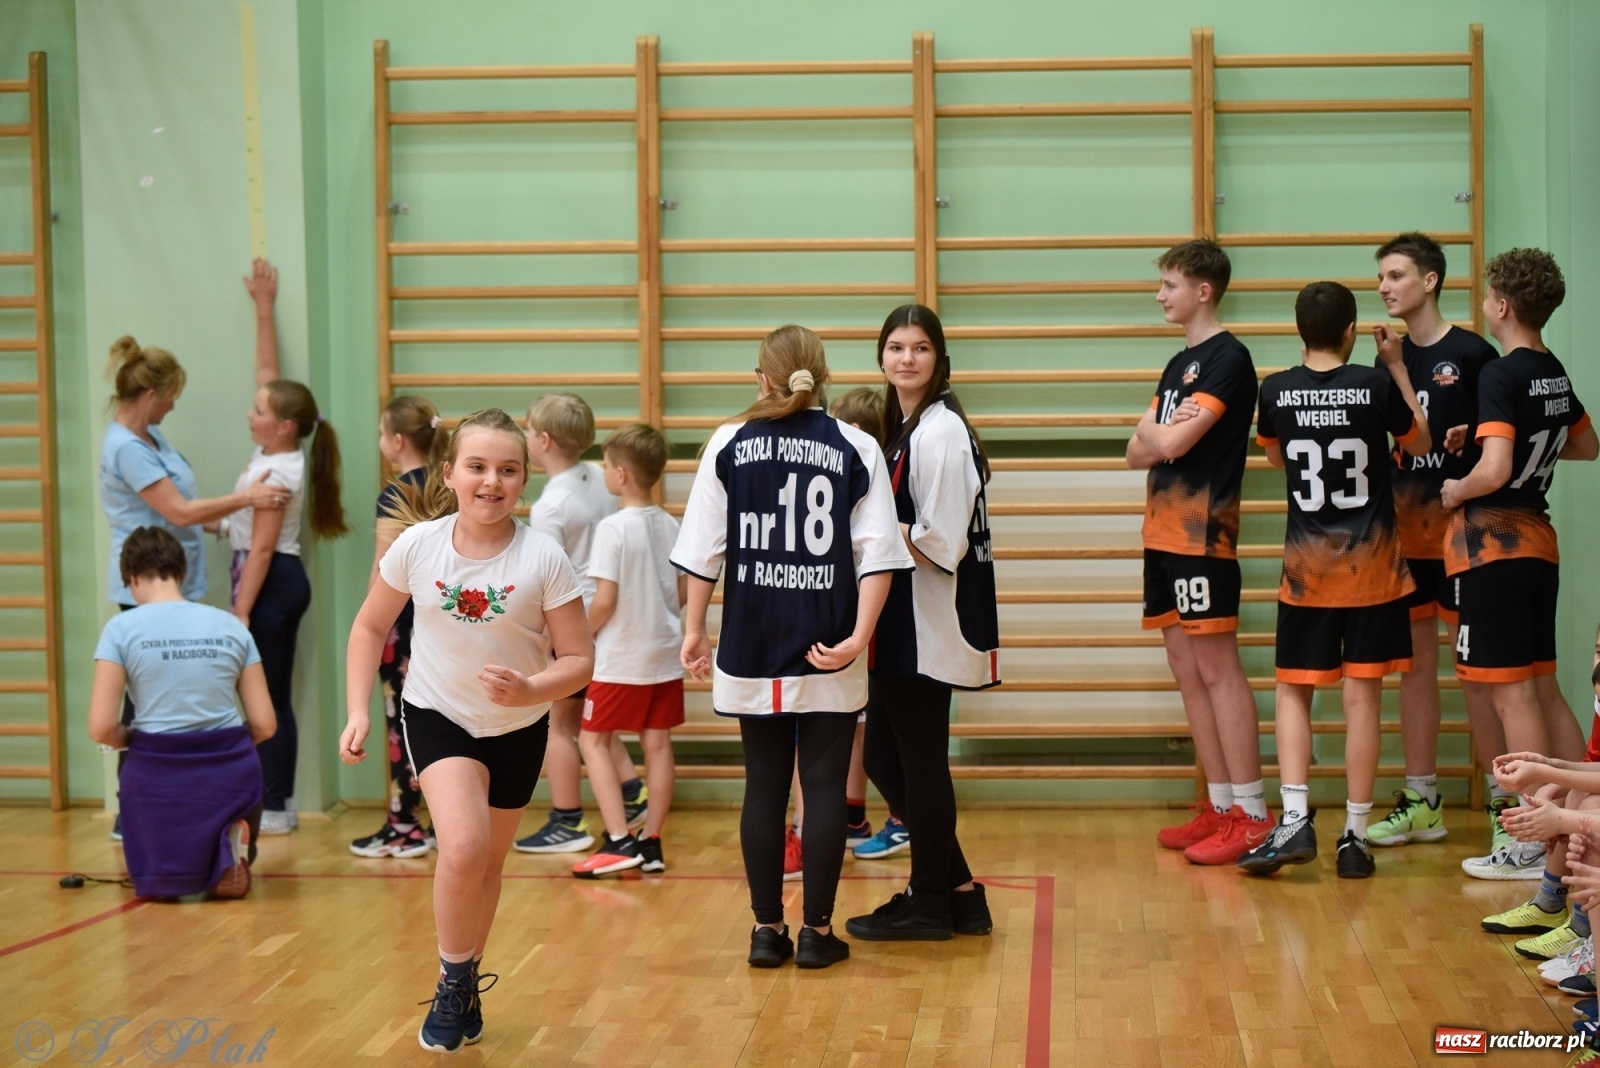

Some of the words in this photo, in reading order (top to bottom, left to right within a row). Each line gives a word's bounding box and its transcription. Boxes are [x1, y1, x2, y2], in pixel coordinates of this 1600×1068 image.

[1276, 388, 1371, 408] JASTRZĘBSKI
[1295, 409, 1351, 429] WĘGIEL
[734, 436, 773, 467] SZKOŁA
[776, 437, 844, 476] PODSTAWOWA
[1285, 438, 1370, 512] 33
[1509, 425, 1569, 491] 14
[778, 472, 834, 556] 18
[754, 561, 835, 590] RACIBORZU
[1174, 576, 1211, 614] 89
[162, 651, 170, 661] W
[172, 649, 218, 661] RACIBORZU
